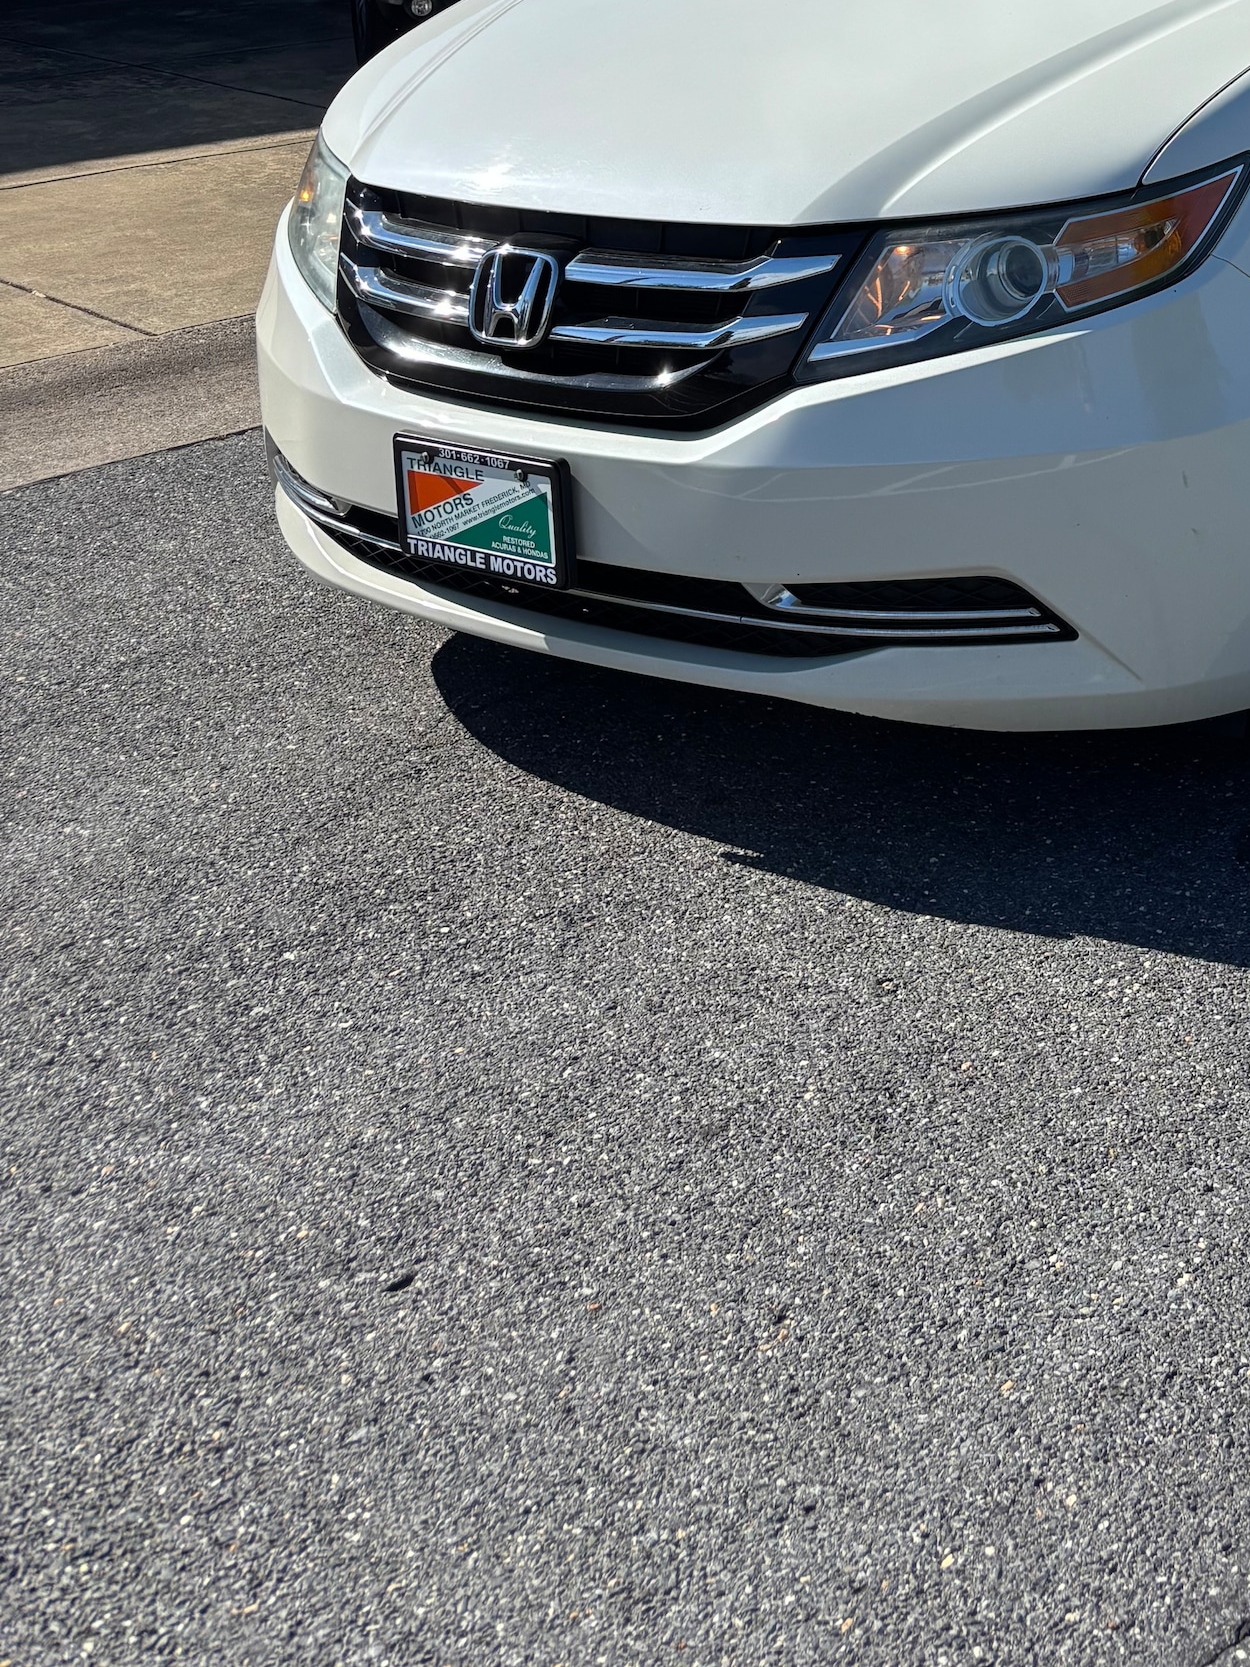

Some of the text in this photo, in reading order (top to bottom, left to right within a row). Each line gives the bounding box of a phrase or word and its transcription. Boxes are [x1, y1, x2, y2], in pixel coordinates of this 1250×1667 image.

[406, 457, 485, 482] TRIANGLE
[411, 492, 474, 529] MOTORS
[431, 517, 455, 530] NORTH
[454, 504, 481, 520] MARKET
[481, 486, 520, 508] FREDERICK,
[519, 480, 531, 490] MD
[462, 487, 536, 526] www.trianglemotors.com
[498, 514, 537, 539] Quality
[502, 535, 536, 548] RESTORED
[407, 538, 558, 585] TRIANGLE MOTORS
[491, 541, 516, 553] ACURAS
[522, 547, 549, 559] HONDAS
